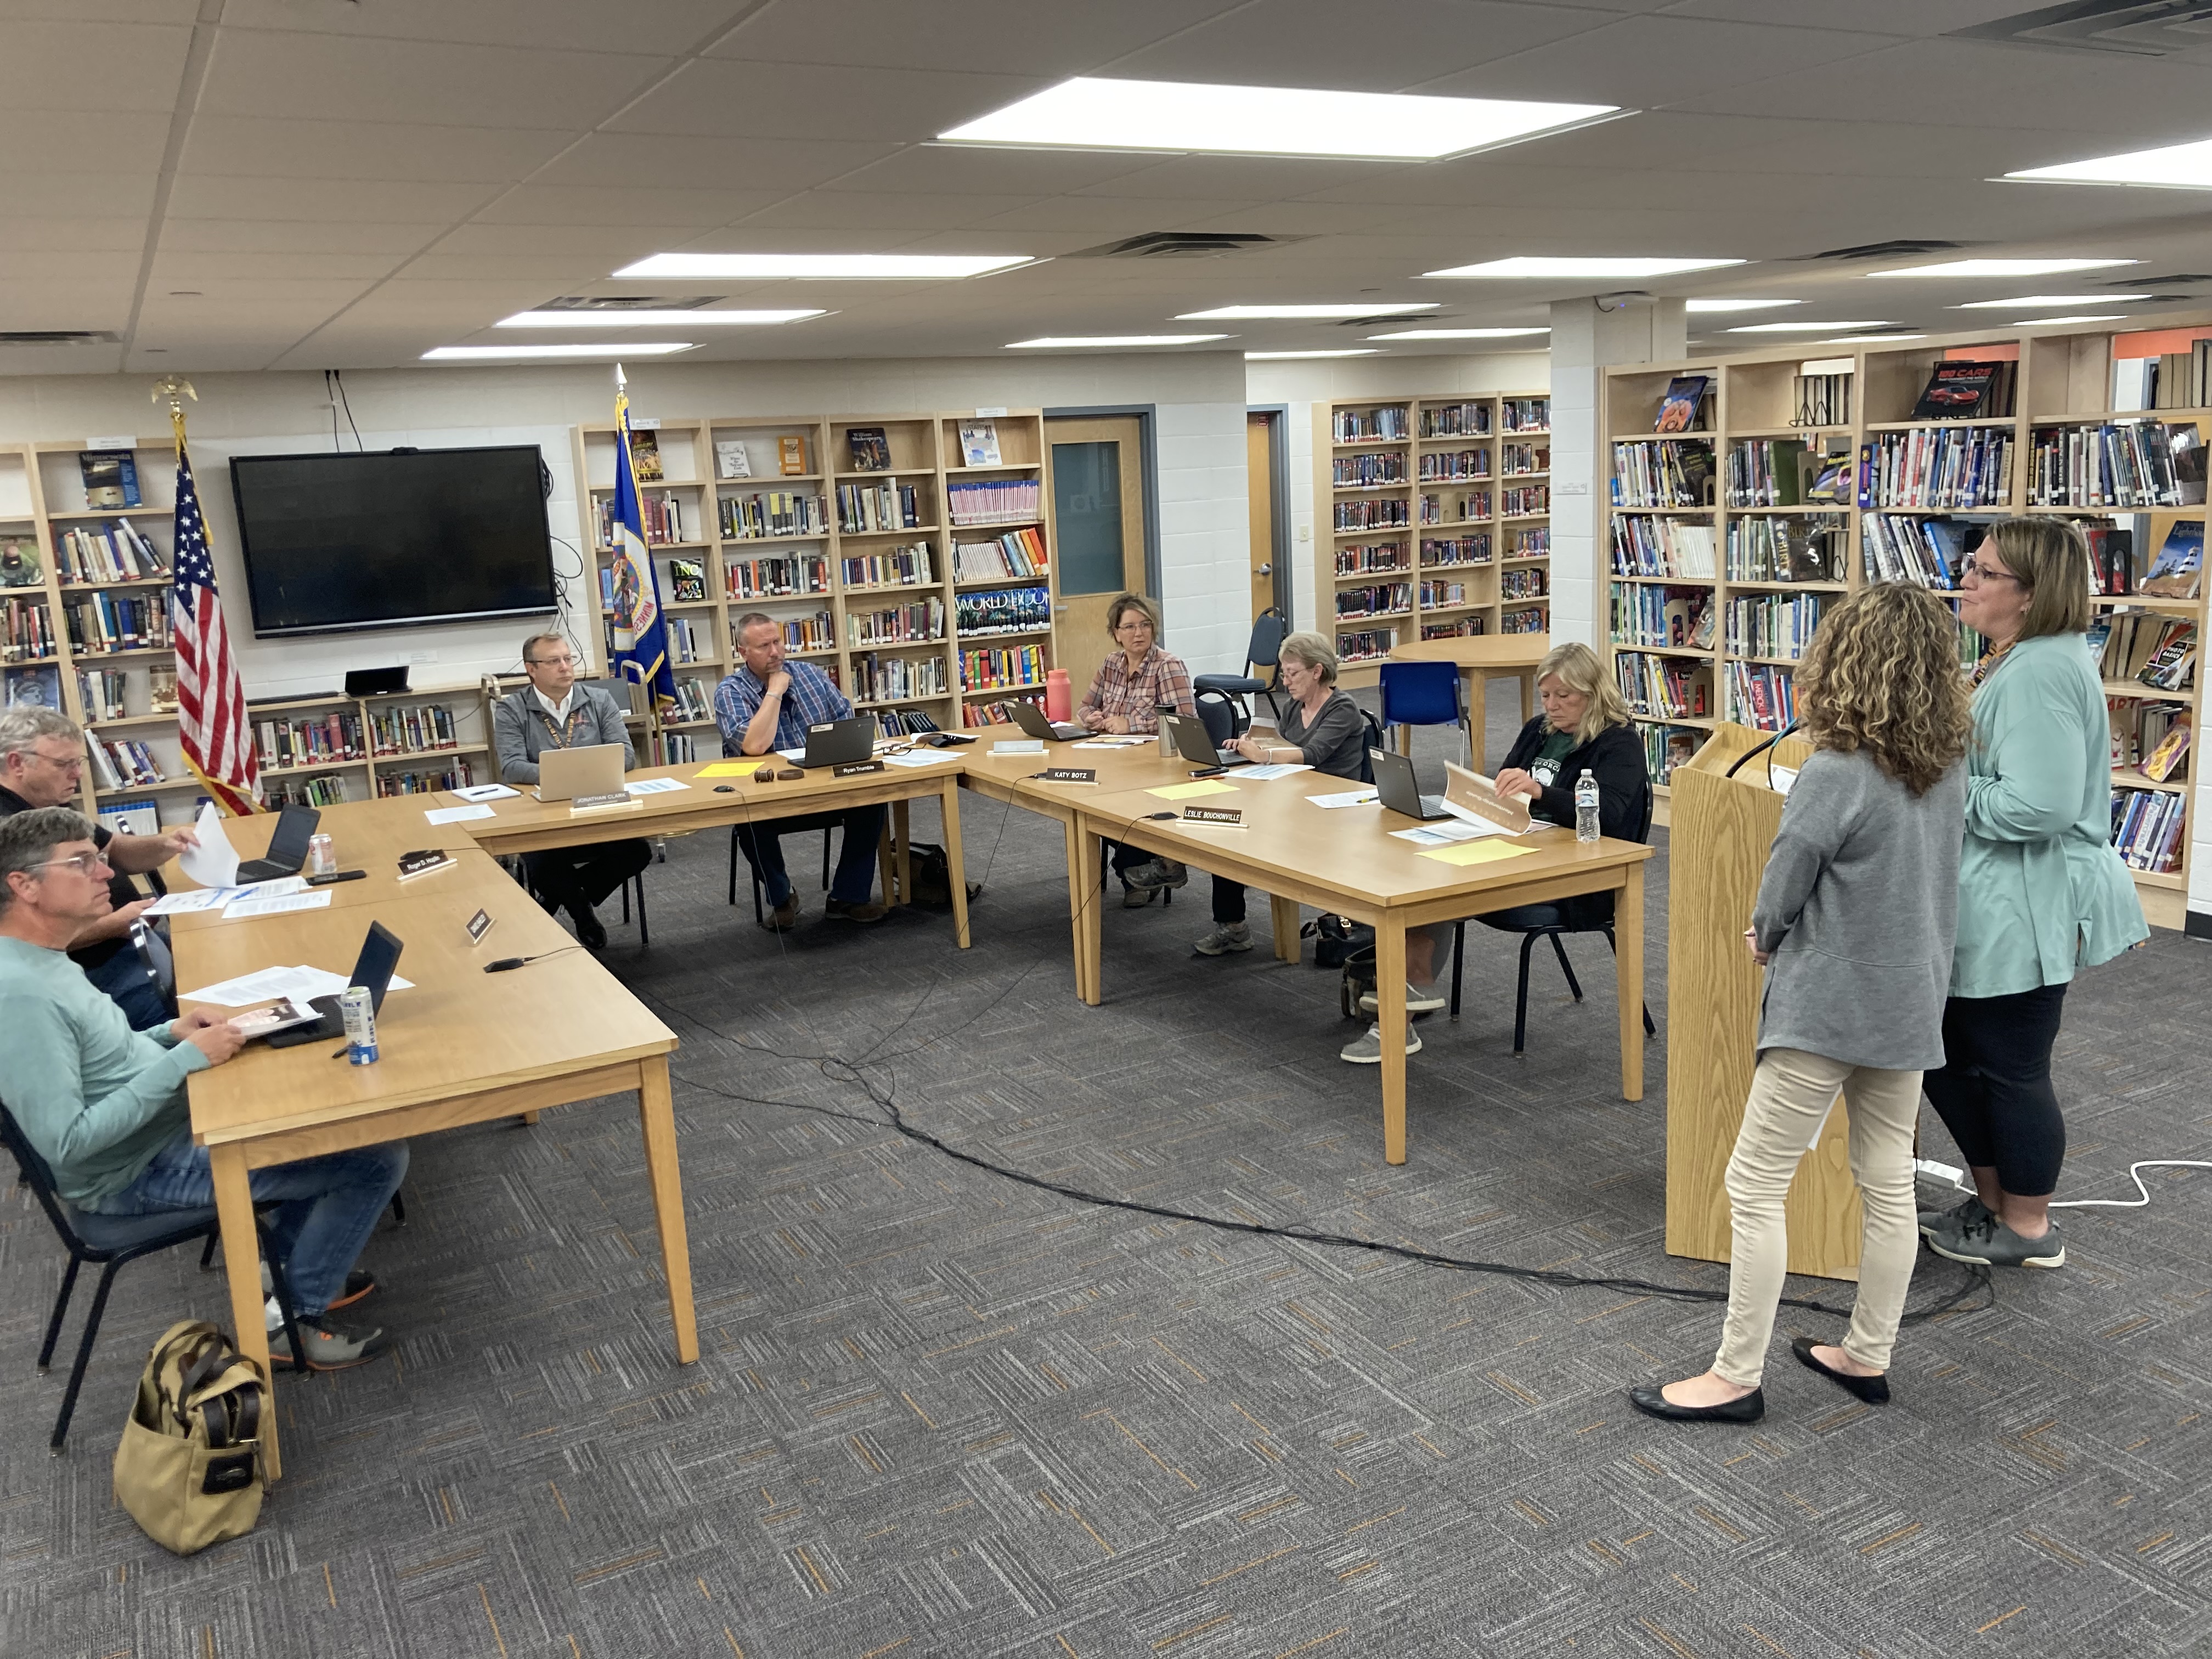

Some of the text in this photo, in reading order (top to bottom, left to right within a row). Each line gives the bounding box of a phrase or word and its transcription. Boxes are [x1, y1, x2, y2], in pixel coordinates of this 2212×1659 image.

[1956, 368, 1993, 377] CARS
[955, 593, 1008, 612] WORLD
[1754, 683, 1764, 708] MERCK
[1543, 761, 1560, 772] ORC
[1184, 810, 1240, 821] LESLIE BOUCHONVILLE
[2137, 804, 2158, 848] Papercrafts
